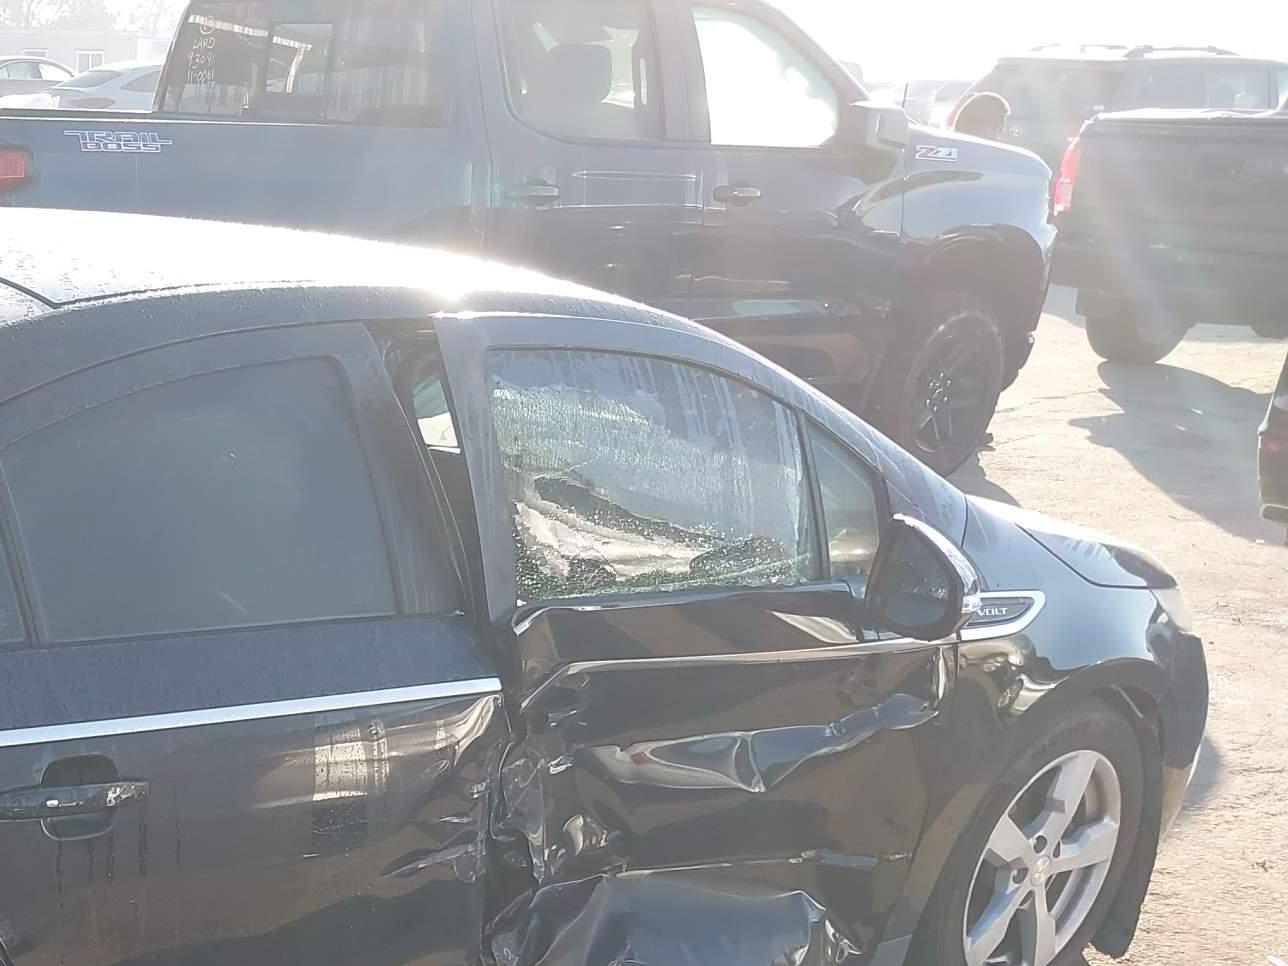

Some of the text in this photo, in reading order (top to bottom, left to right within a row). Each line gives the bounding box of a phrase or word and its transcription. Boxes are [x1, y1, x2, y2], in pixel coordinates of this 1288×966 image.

[63, 130, 173, 145] TRAIL
[80, 142, 161, 153] BOSS
[977, 607, 1008, 616] VOLT
